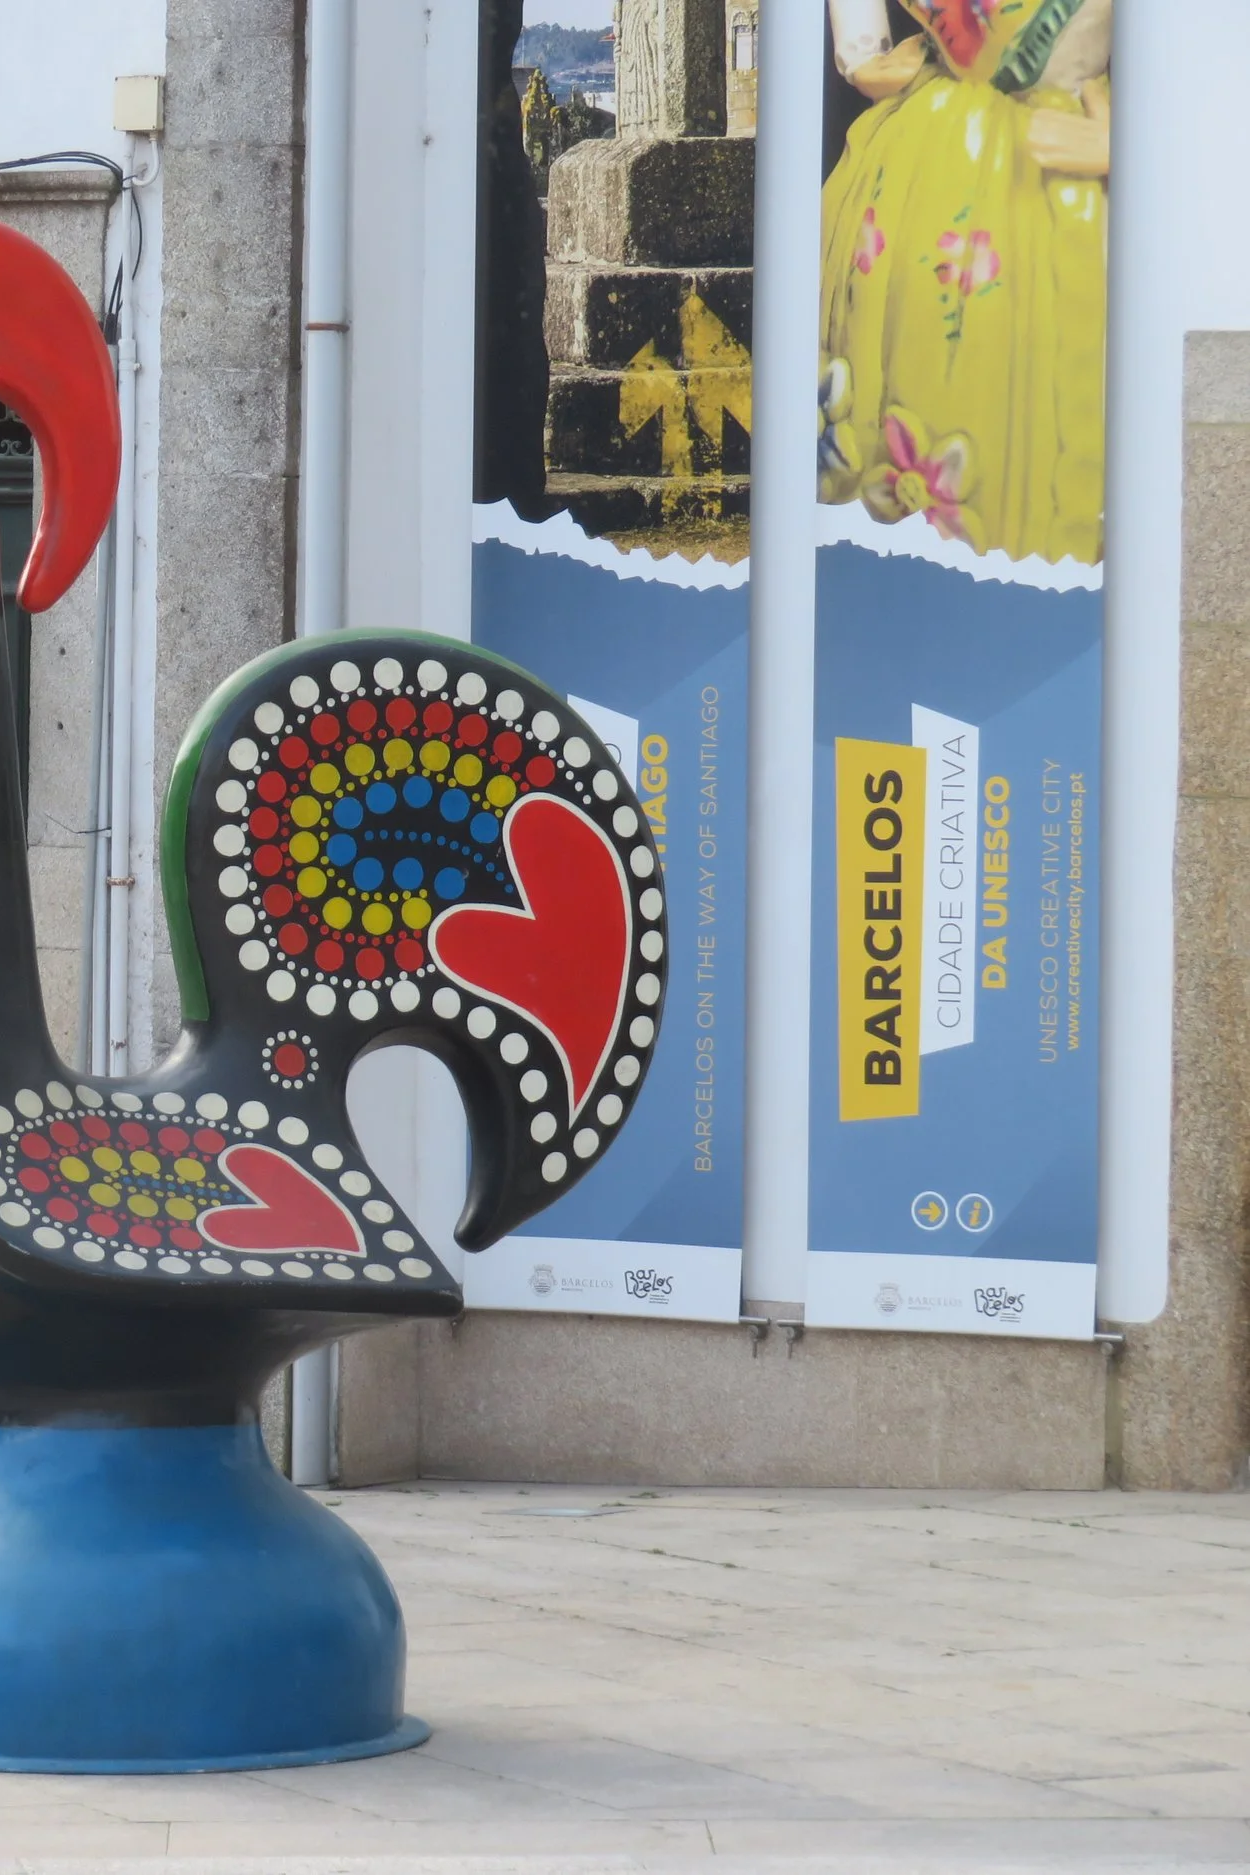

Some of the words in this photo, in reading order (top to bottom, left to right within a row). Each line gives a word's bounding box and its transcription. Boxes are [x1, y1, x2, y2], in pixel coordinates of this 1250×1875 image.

[641, 733, 669, 873] IAGO
[699, 685, 719, 815] SANTIAGO
[939, 734, 966, 890] CRIATIVA
[1042, 757, 1062, 814] CITY
[697, 869, 716, 927] WAY
[699, 824, 717, 859] OF
[984, 775, 1010, 928] UNESCO
[1040, 823, 1061, 951] CREATIVE
[697, 935, 716, 985] THE
[864, 769, 903, 1086] BARCELOS
[937, 901, 963, 1028] CIDADE
[982, 936, 1007, 989] DA
[1066, 772, 1087, 1051] www.creativecity.barcelos.pt
[696, 993, 715, 1027] ON
[1039, 956, 1058, 1063] UNESCO
[694, 1036, 715, 1172] BARCELOS
[561, 1277, 615, 1288] BARCELOS
